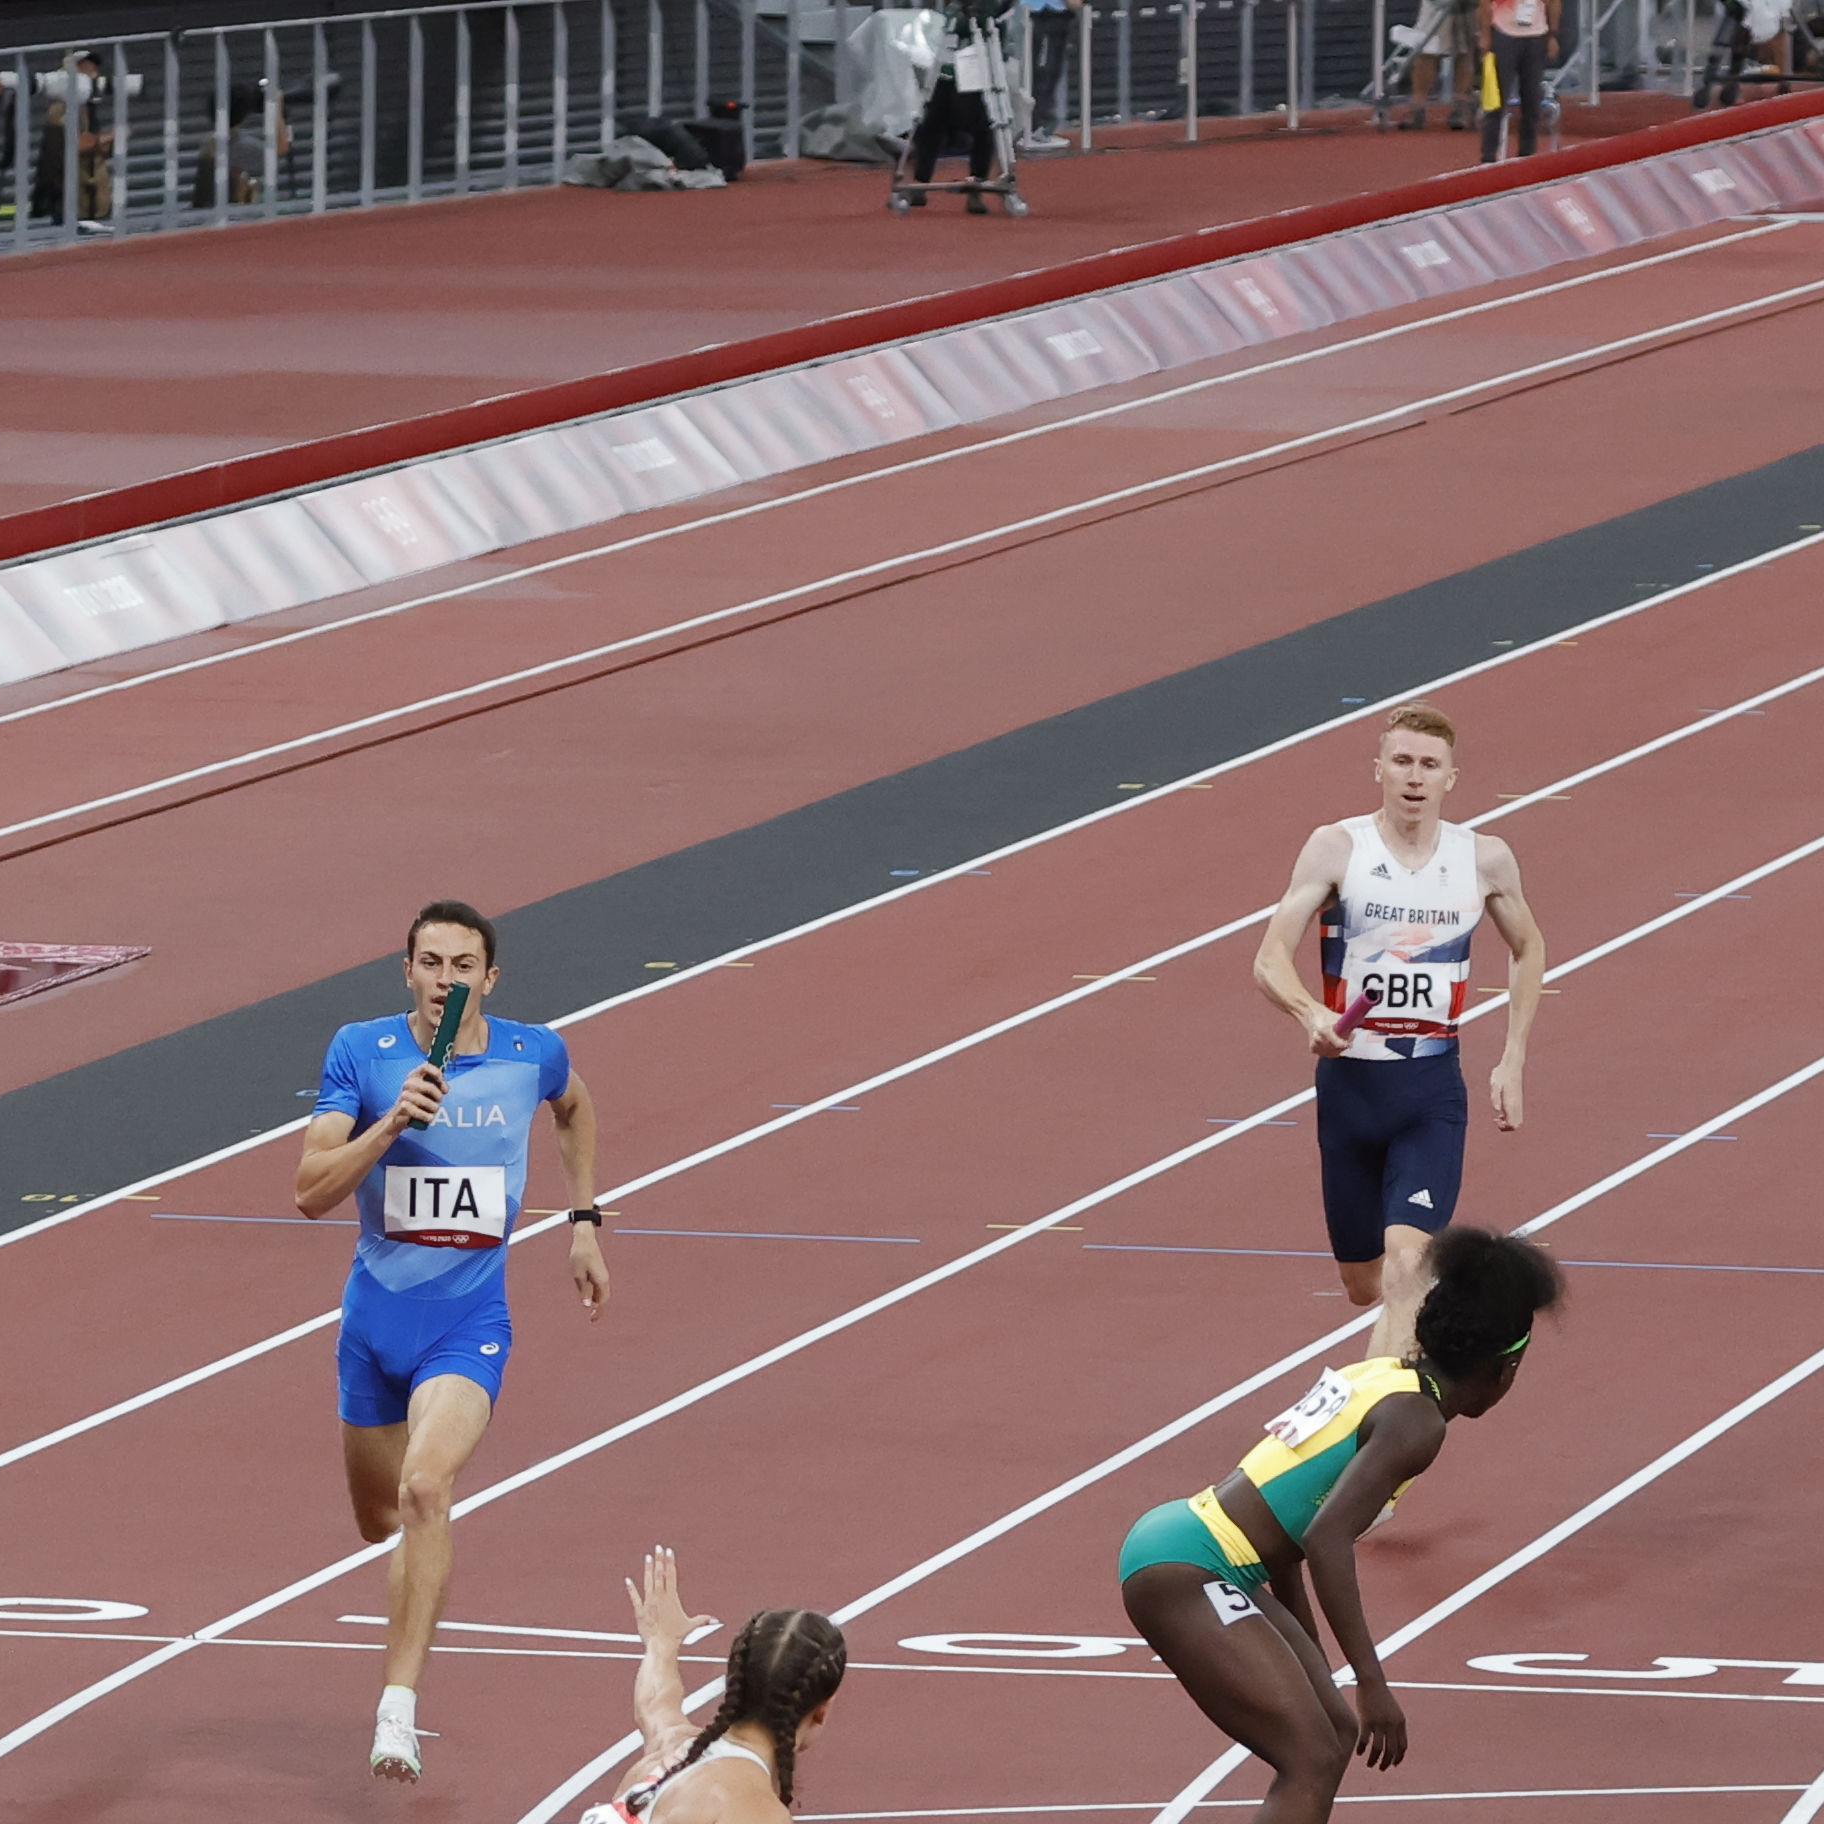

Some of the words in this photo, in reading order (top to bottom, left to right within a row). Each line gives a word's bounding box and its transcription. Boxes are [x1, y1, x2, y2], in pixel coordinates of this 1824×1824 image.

[1364, 902, 1405, 922] GREAT
[1408, 908, 1461, 925] BRITAIN
[1362, 973, 1433, 1008] GBR
[429, 1104, 507, 1128] ALIA
[408, 1177, 480, 1219] ITA
[1218, 1582, 1251, 1612] 5
